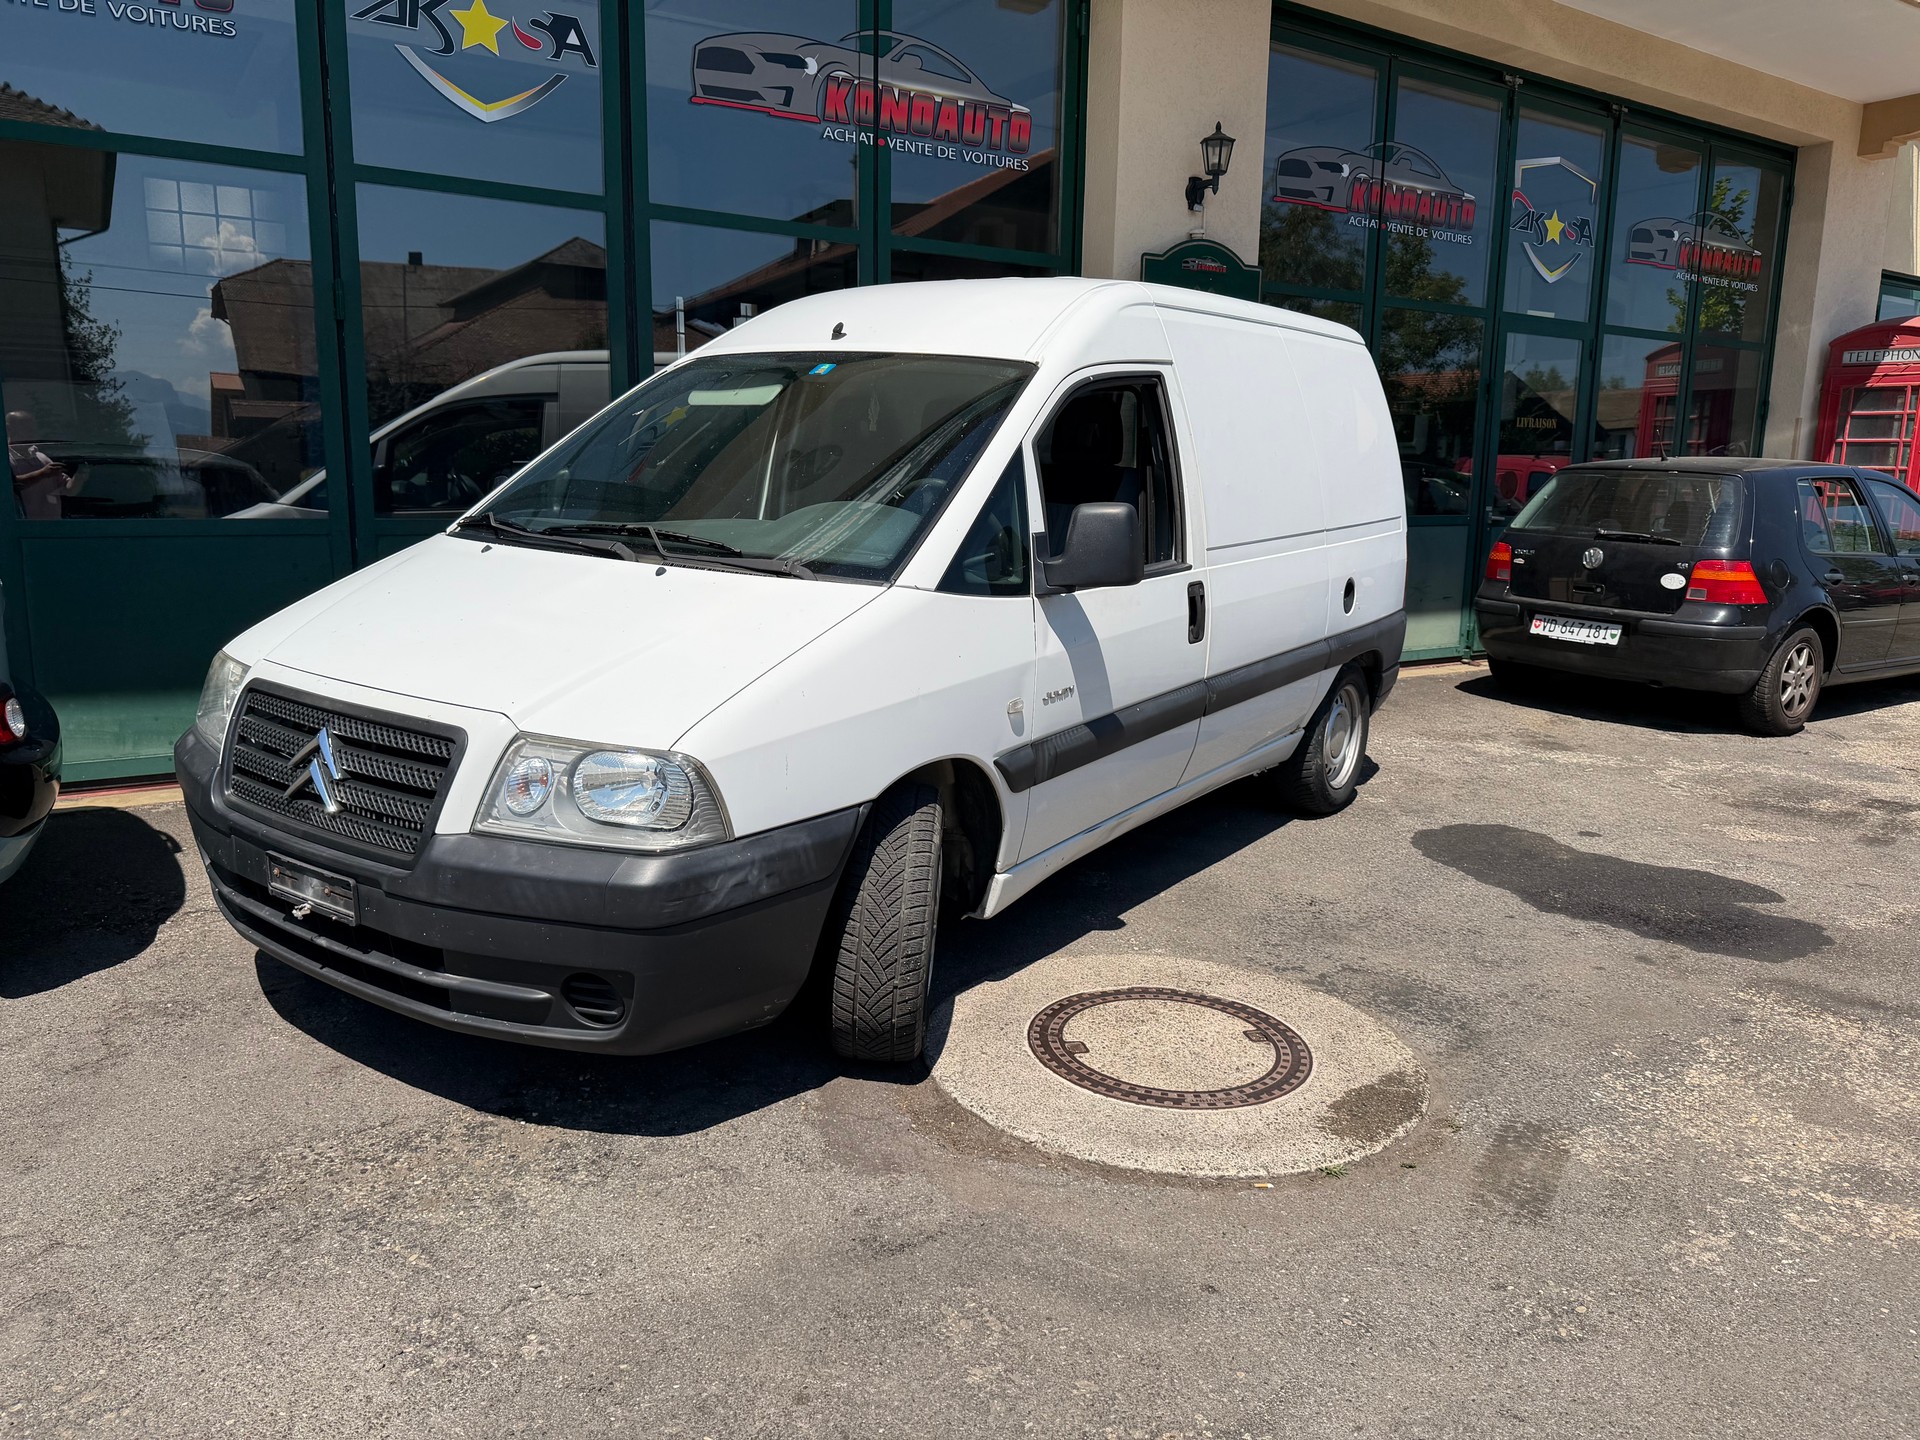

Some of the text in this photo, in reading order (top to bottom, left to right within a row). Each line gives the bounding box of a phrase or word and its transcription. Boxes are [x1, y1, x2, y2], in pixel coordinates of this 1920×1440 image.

[58, 0, 95, 14] DE
[106, 0, 237, 37] VOITURES
[824, 76, 1032, 154] KONOAUTO
[823, 127, 1029, 171] ACHAT VENTE DE VOITURES
[1350, 179, 1477, 231] KONOAUTO
[1348, 216, 1473, 245] ACHAT VENTE DE VOITURES
[1679, 241, 1762, 280] KONOAUTO
[1720, 279, 1729, 288] DE
[1730, 281, 1759, 292] VOITURES
[1516, 417, 1558, 429] LIVRAISON
[1542, 617, 1558, 633] VD
